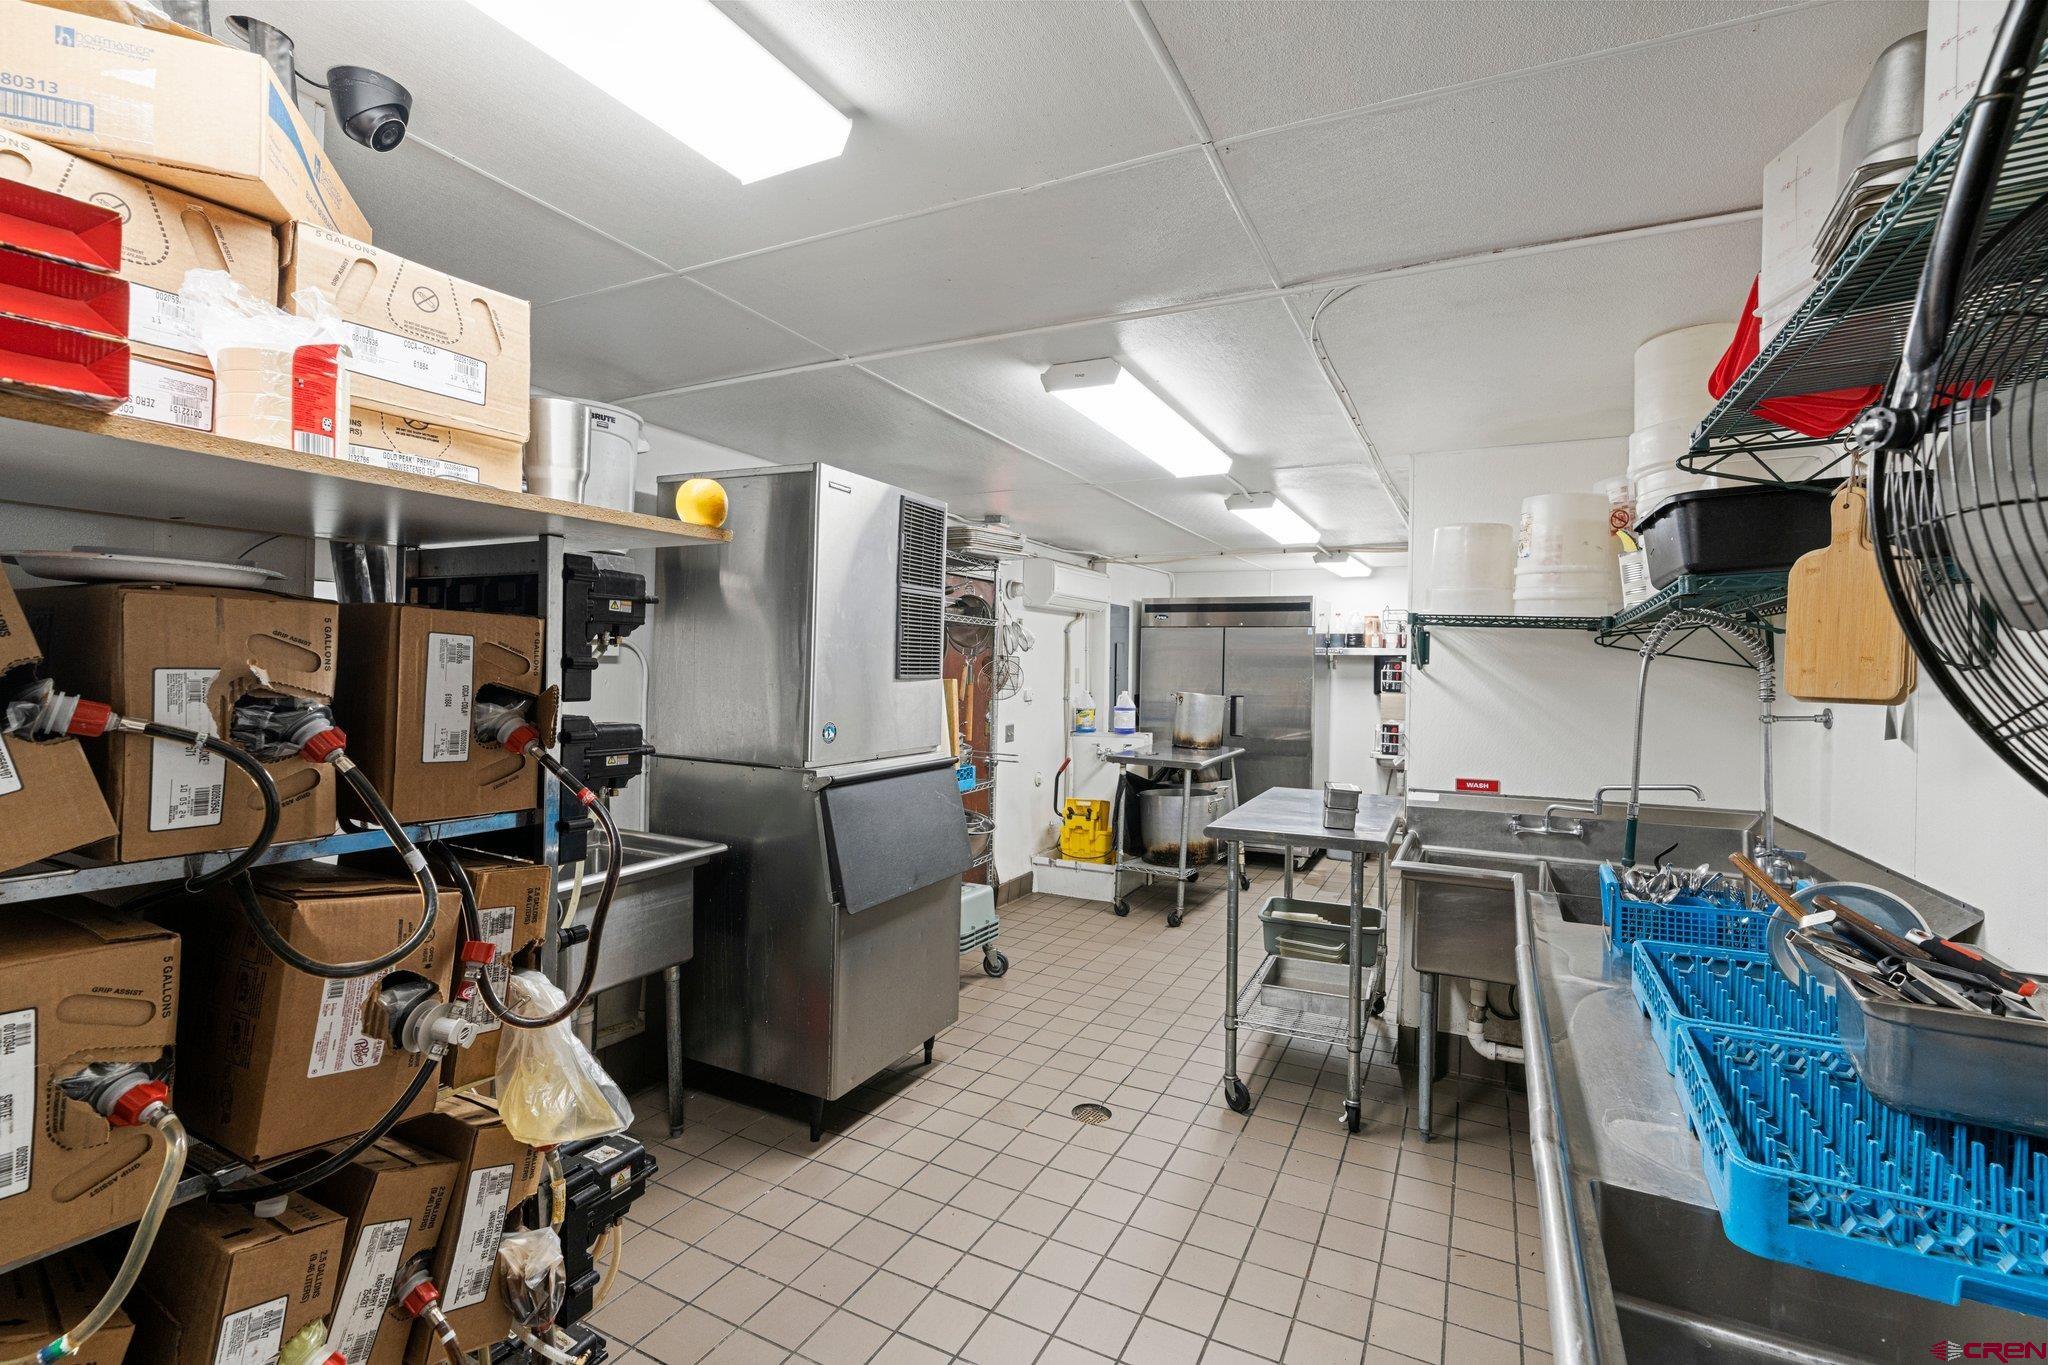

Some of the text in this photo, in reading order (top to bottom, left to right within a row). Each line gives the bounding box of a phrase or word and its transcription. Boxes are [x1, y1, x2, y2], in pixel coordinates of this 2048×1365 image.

[214, 224, 234, 262] GRIP ASSIST
[326, 234, 376, 256] GALLONS
[136, 395, 156, 408] ZERO
[591, 413, 616, 424] BRUTE
[383, 452, 397, 461] GOLD
[399, 454, 412, 463] PEAK
[416, 457, 440, 468] PREMIUM
[387, 461, 426, 476] UNSWEETENED
[272, 630, 312, 648] GRIP ASSIST
[324, 626, 334, 672] GALLONS
[532, 896, 540, 924] GALLONS
[113, 988, 144, 996] ASSIST
[162, 965, 173, 1019] GALLONS
[89, 1162, 141, 1199] GRIP ASSIST
[418, 1206, 434, 1231] LITERS)
[428, 1196, 443, 1229] GALLONS
[482, 1211, 497, 1248] UNSWEETENED
[487, 1237, 501, 1261] PREMIUM
[300, 1253, 317, 1303] (9.46 LITERS)
[312, 1250, 328, 1299] 2.5 GALLONS
[368, 1274, 384, 1307] RASPBERRY
[377, 1277, 392, 1310] GOLD PEAK
[364, 1309, 373, 1320] TEA
